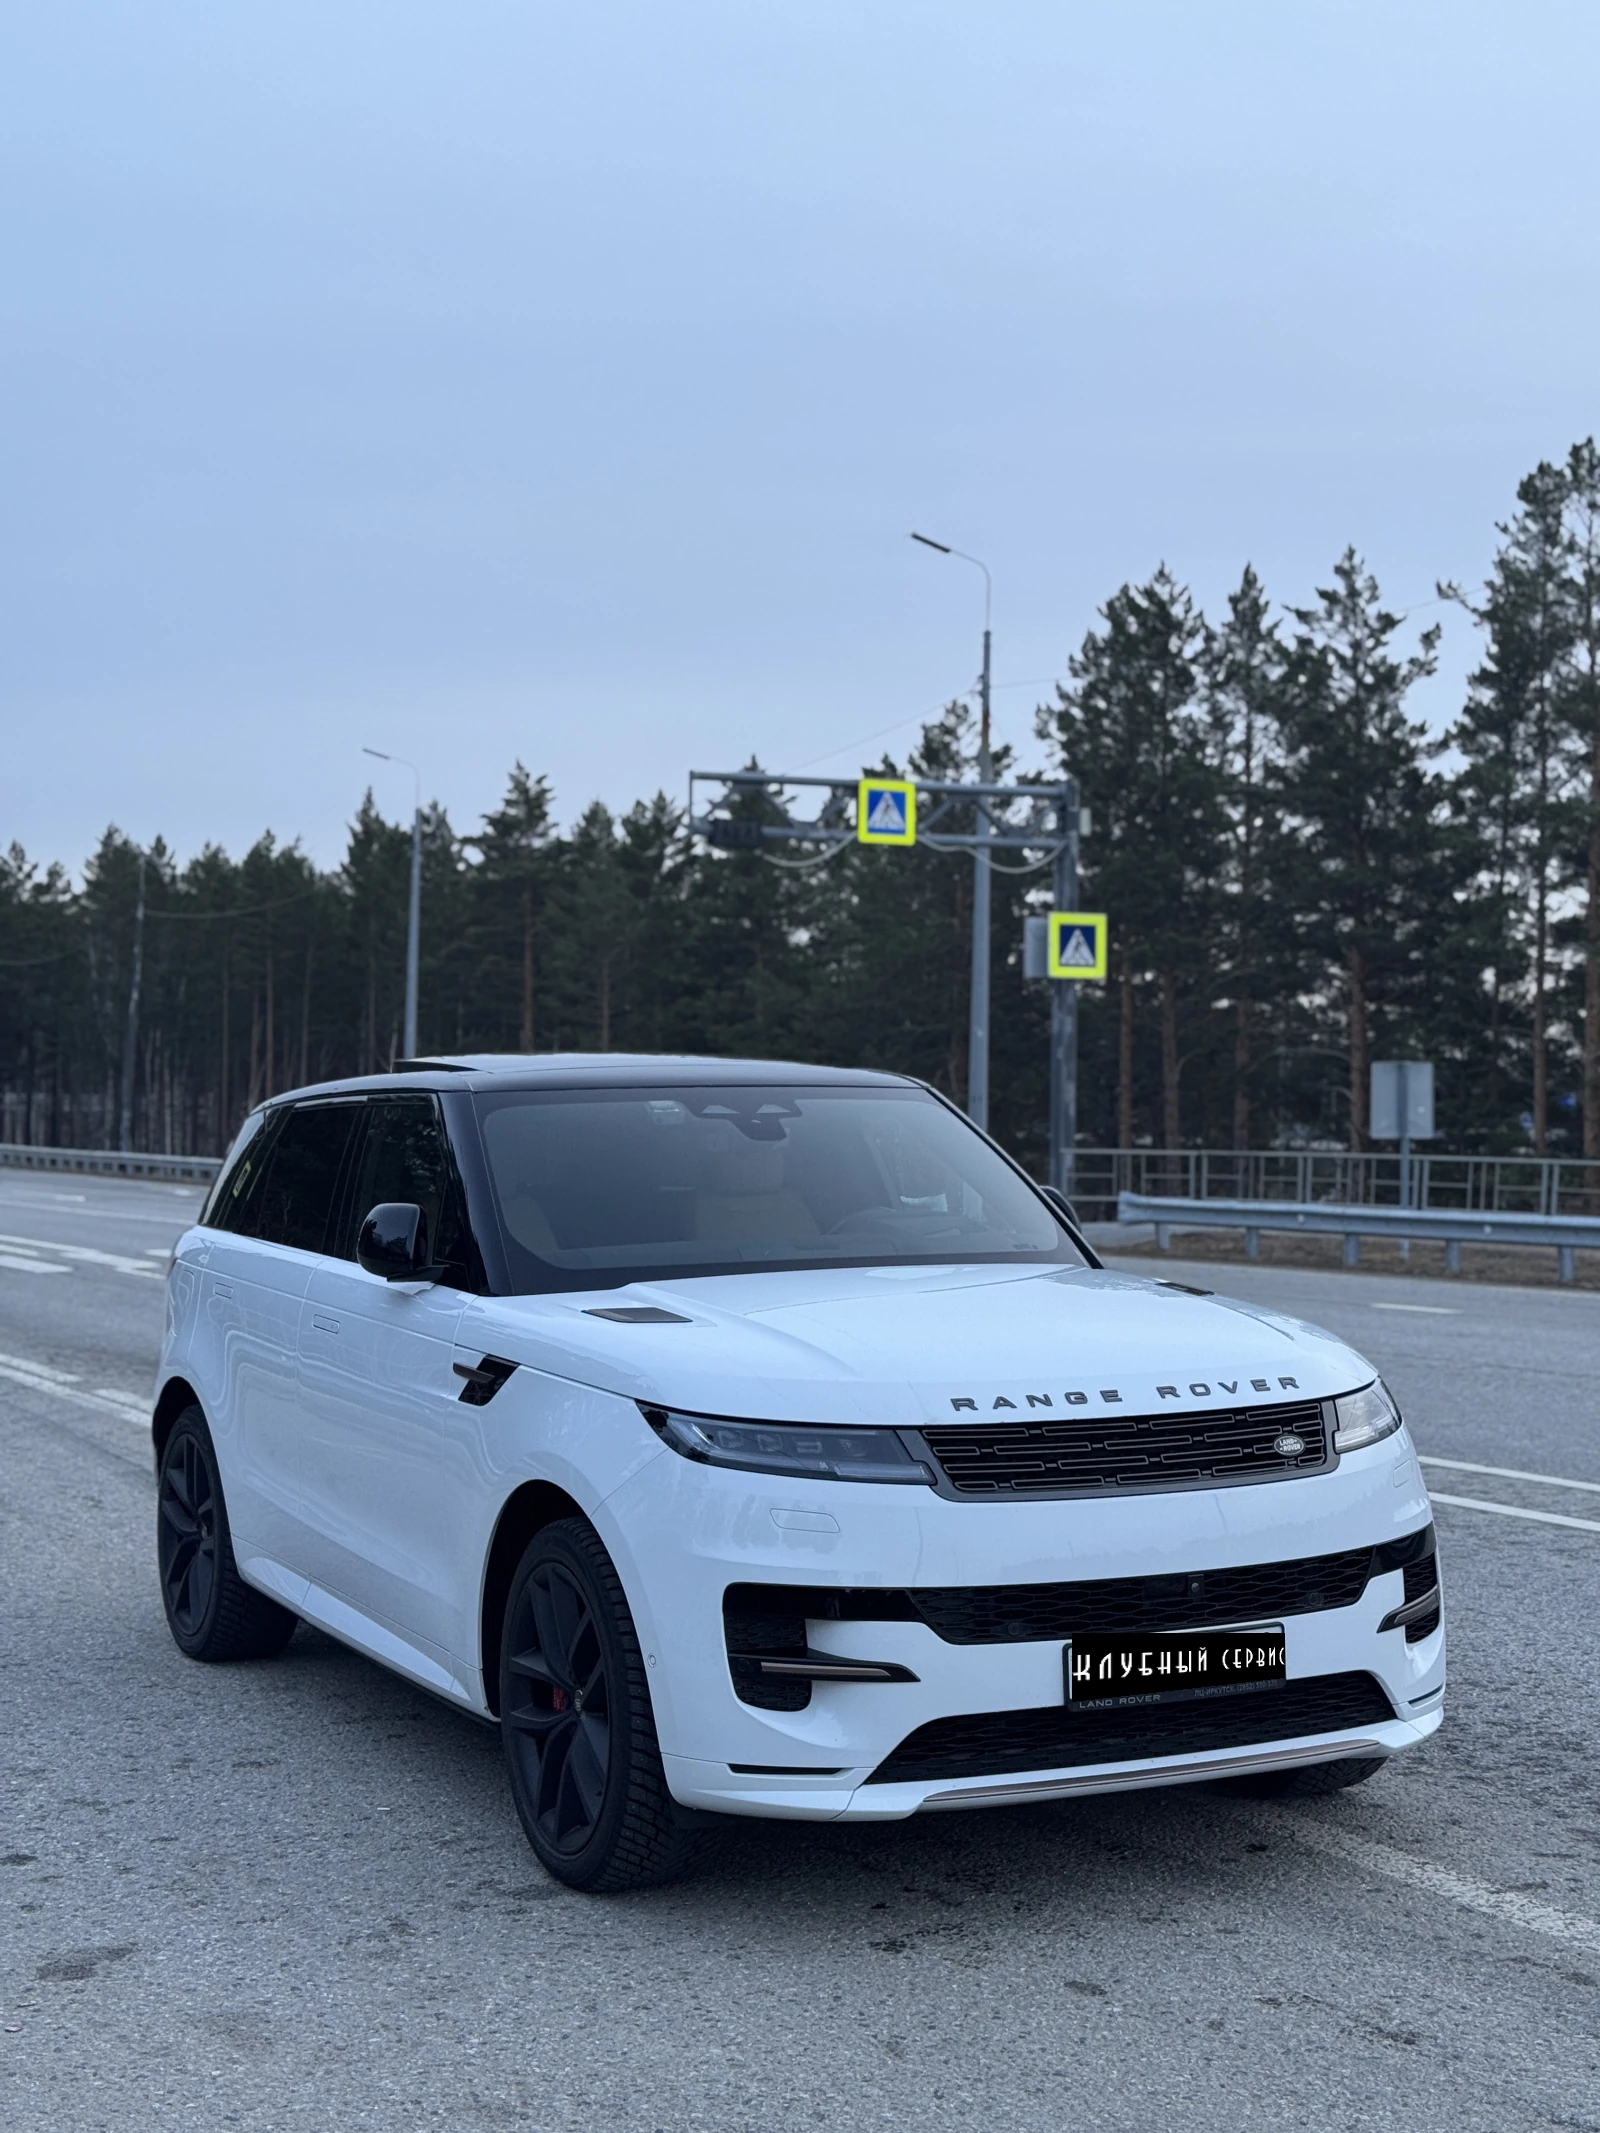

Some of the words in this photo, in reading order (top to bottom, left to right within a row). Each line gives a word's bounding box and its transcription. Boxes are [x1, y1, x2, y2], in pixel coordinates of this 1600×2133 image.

[950, 1388, 1122, 1412] RANGE
[1156, 1376, 1300, 1399] ROVER
[1079, 1699, 1113, 1709] LAND
[1119, 1694, 1161, 1705] ROVER
